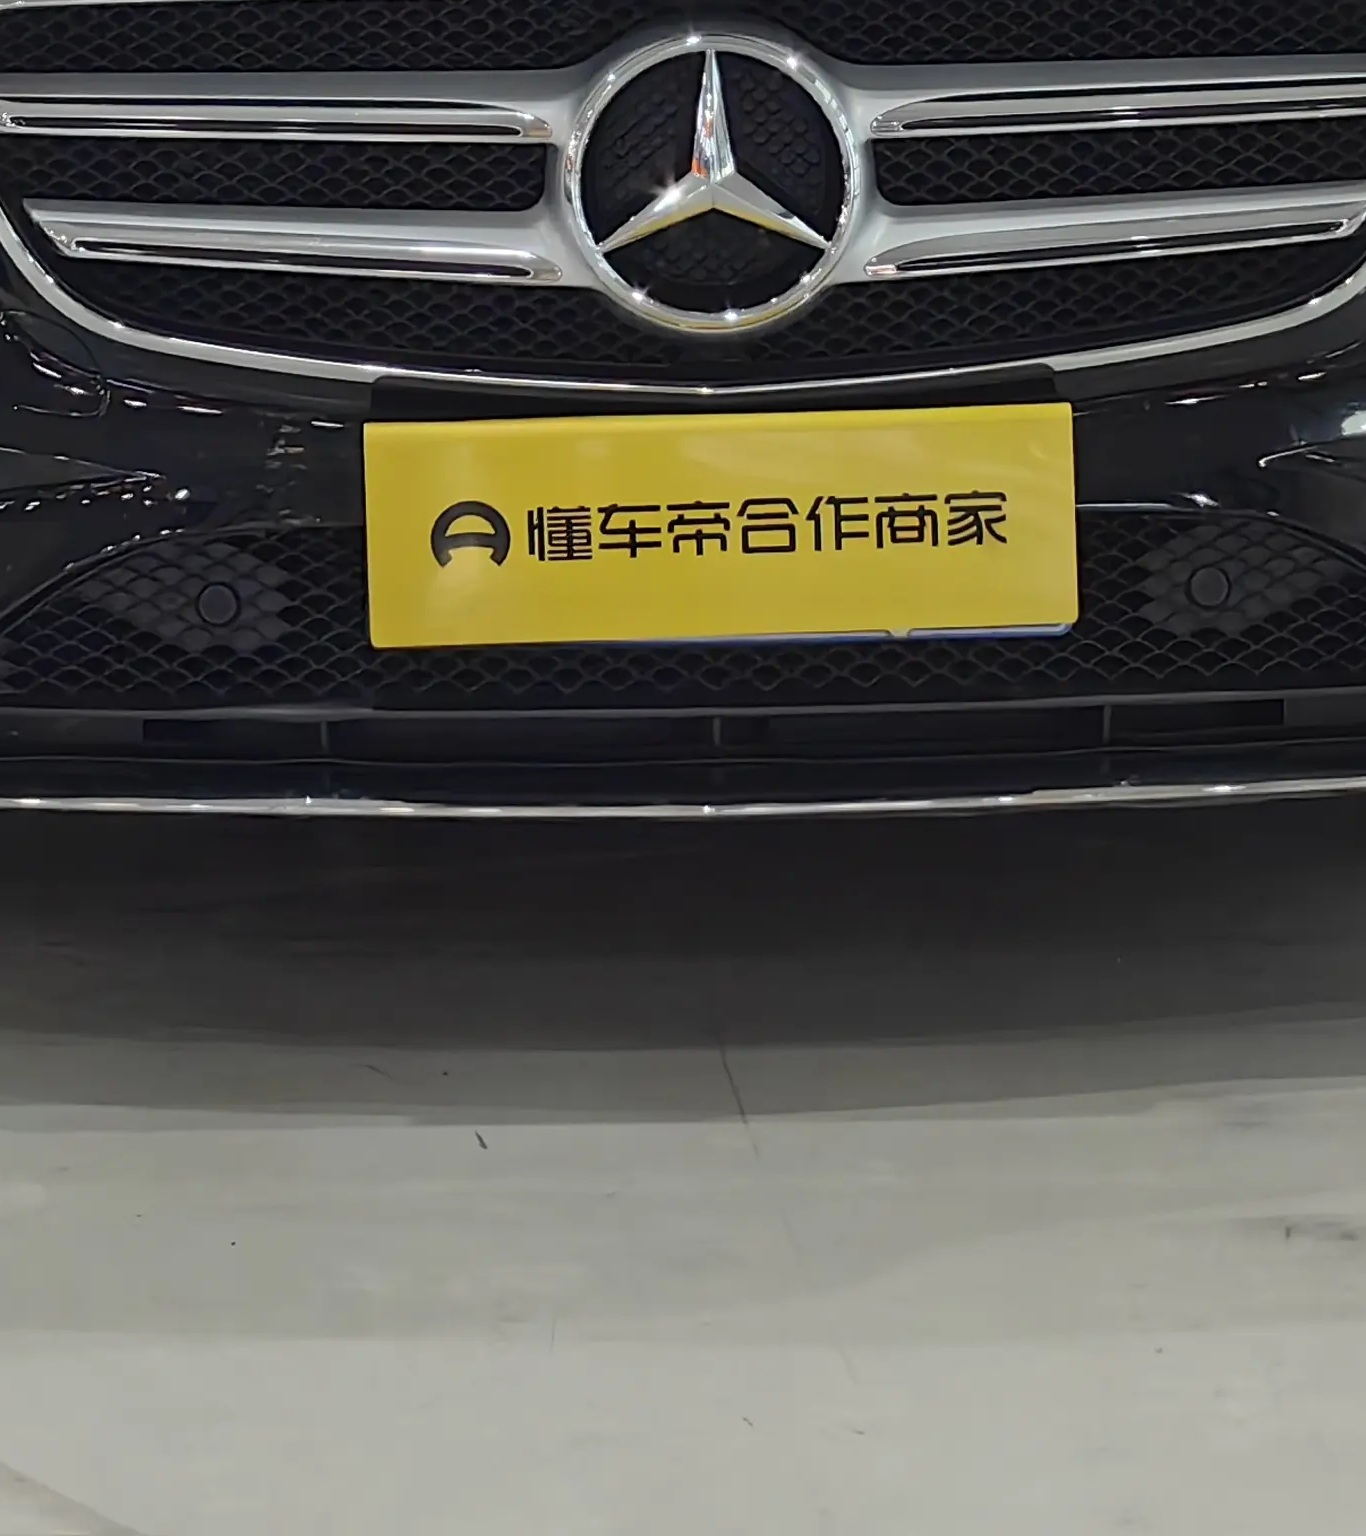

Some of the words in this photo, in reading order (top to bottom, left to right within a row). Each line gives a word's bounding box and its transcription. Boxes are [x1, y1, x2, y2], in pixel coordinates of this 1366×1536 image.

[526, 489, 1010, 563] 懂车帝合作商家
